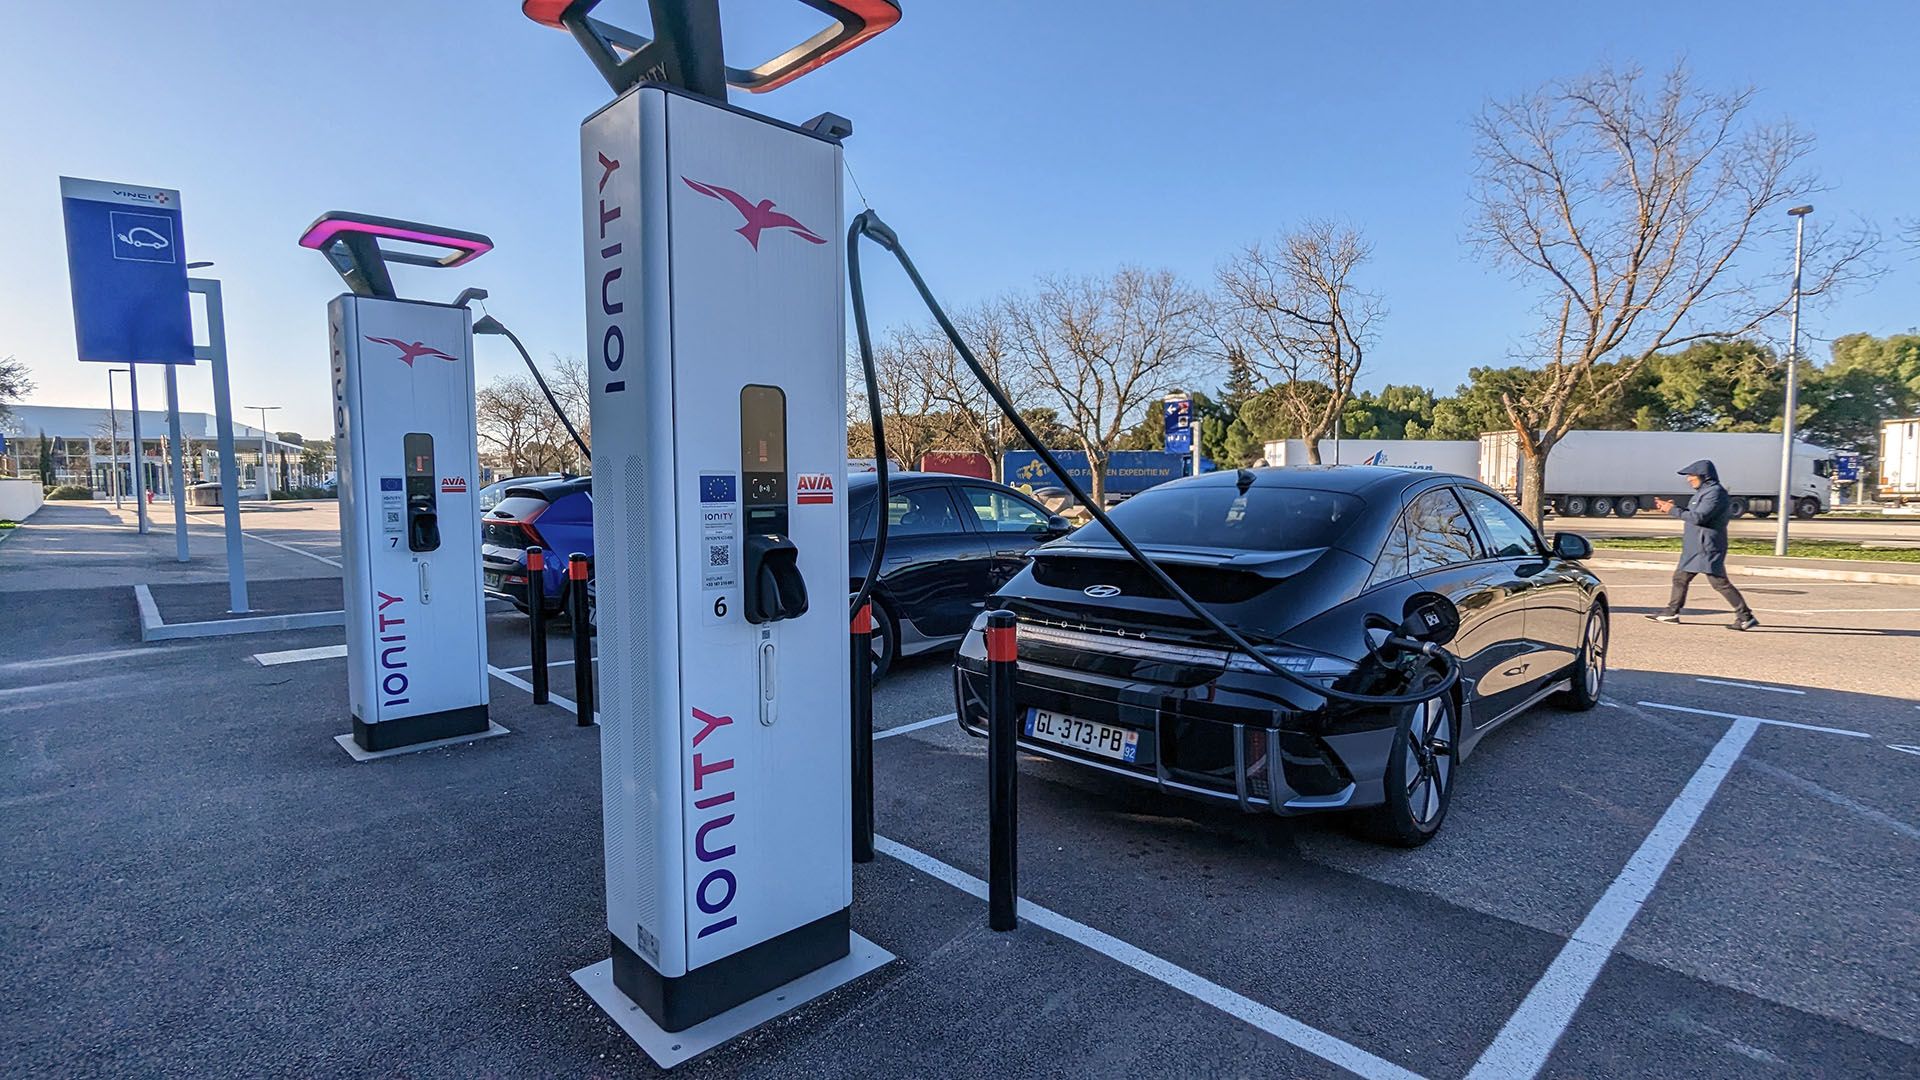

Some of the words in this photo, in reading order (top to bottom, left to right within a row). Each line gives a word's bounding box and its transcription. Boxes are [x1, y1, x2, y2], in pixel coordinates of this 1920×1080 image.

[112, 190, 152, 199] VINCI
[599, 151, 625, 393] IONITY
[332, 322, 345, 439] IONITY
[1119, 468, 1158, 477] EXPEDITIE
[1159, 468, 1170, 477] NV
[704, 512, 733, 521] IONITY
[390, 537, 399, 548] 7
[714, 596, 728, 618] 6
[377, 591, 410, 706] IONITY
[1124, 746, 1136, 759] 92
[692, 706, 738, 939] IONITY
